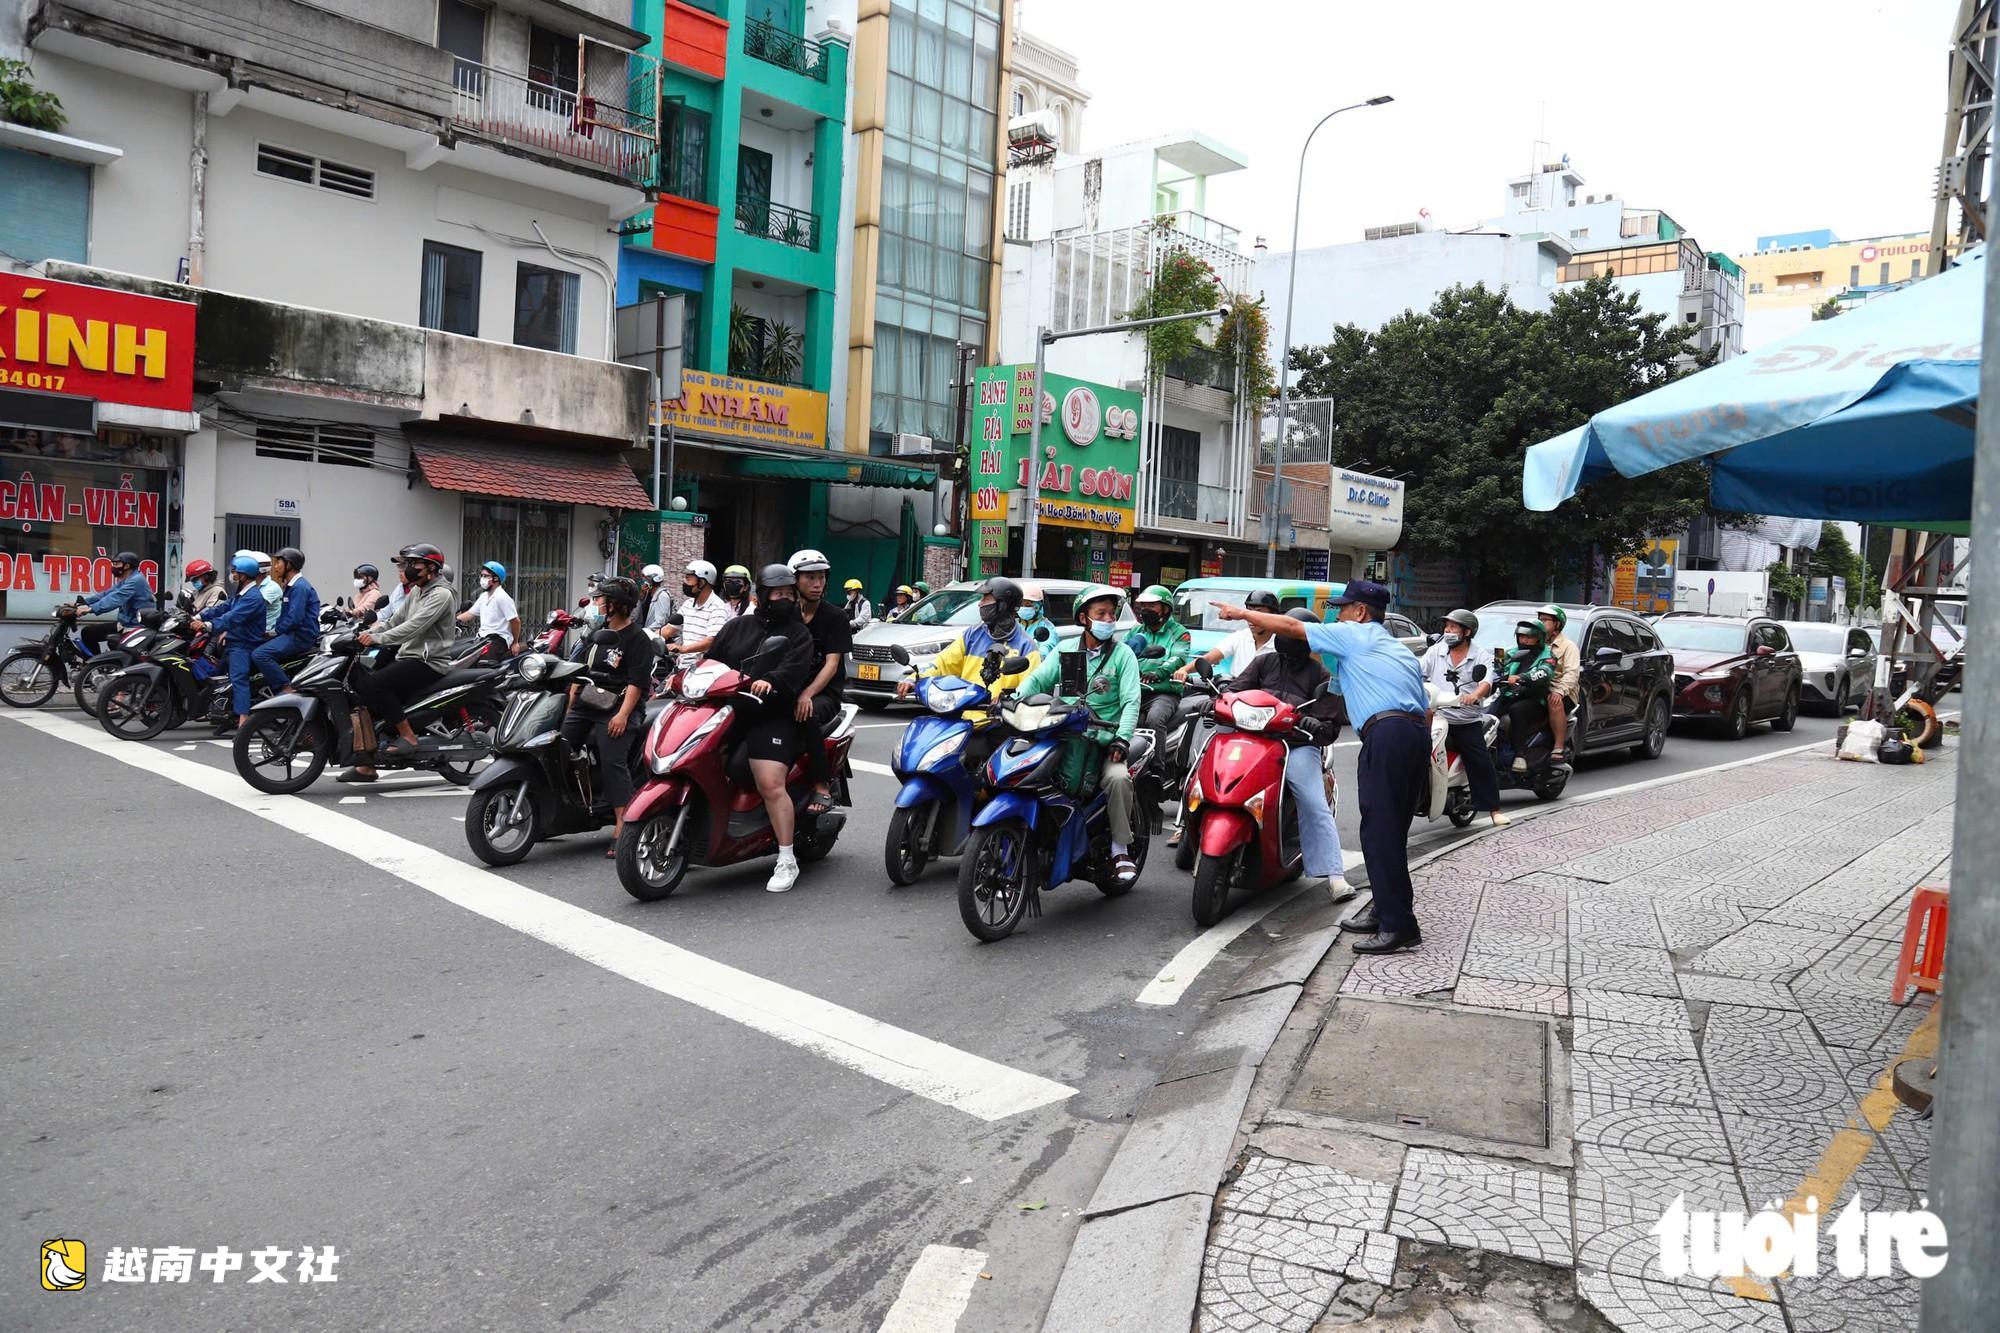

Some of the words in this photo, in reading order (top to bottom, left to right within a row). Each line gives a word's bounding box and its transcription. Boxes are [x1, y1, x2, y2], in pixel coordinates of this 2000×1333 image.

[981, 373, 1007, 405] BÁNH
[701, 392, 789, 426] NHÂM
[983, 408, 1002, 440] PÍA
[979, 441, 1001, 474] HẢI
[977, 483, 1000, 512] SƠN
[1079, 466, 1133, 500] SƠN
[279, 500, 296, 508] 59A
[1368, 491, 1390, 508] Clinic
[43, 547, 158, 594] TRÒG
[1093, 551, 1105, 561] 61
